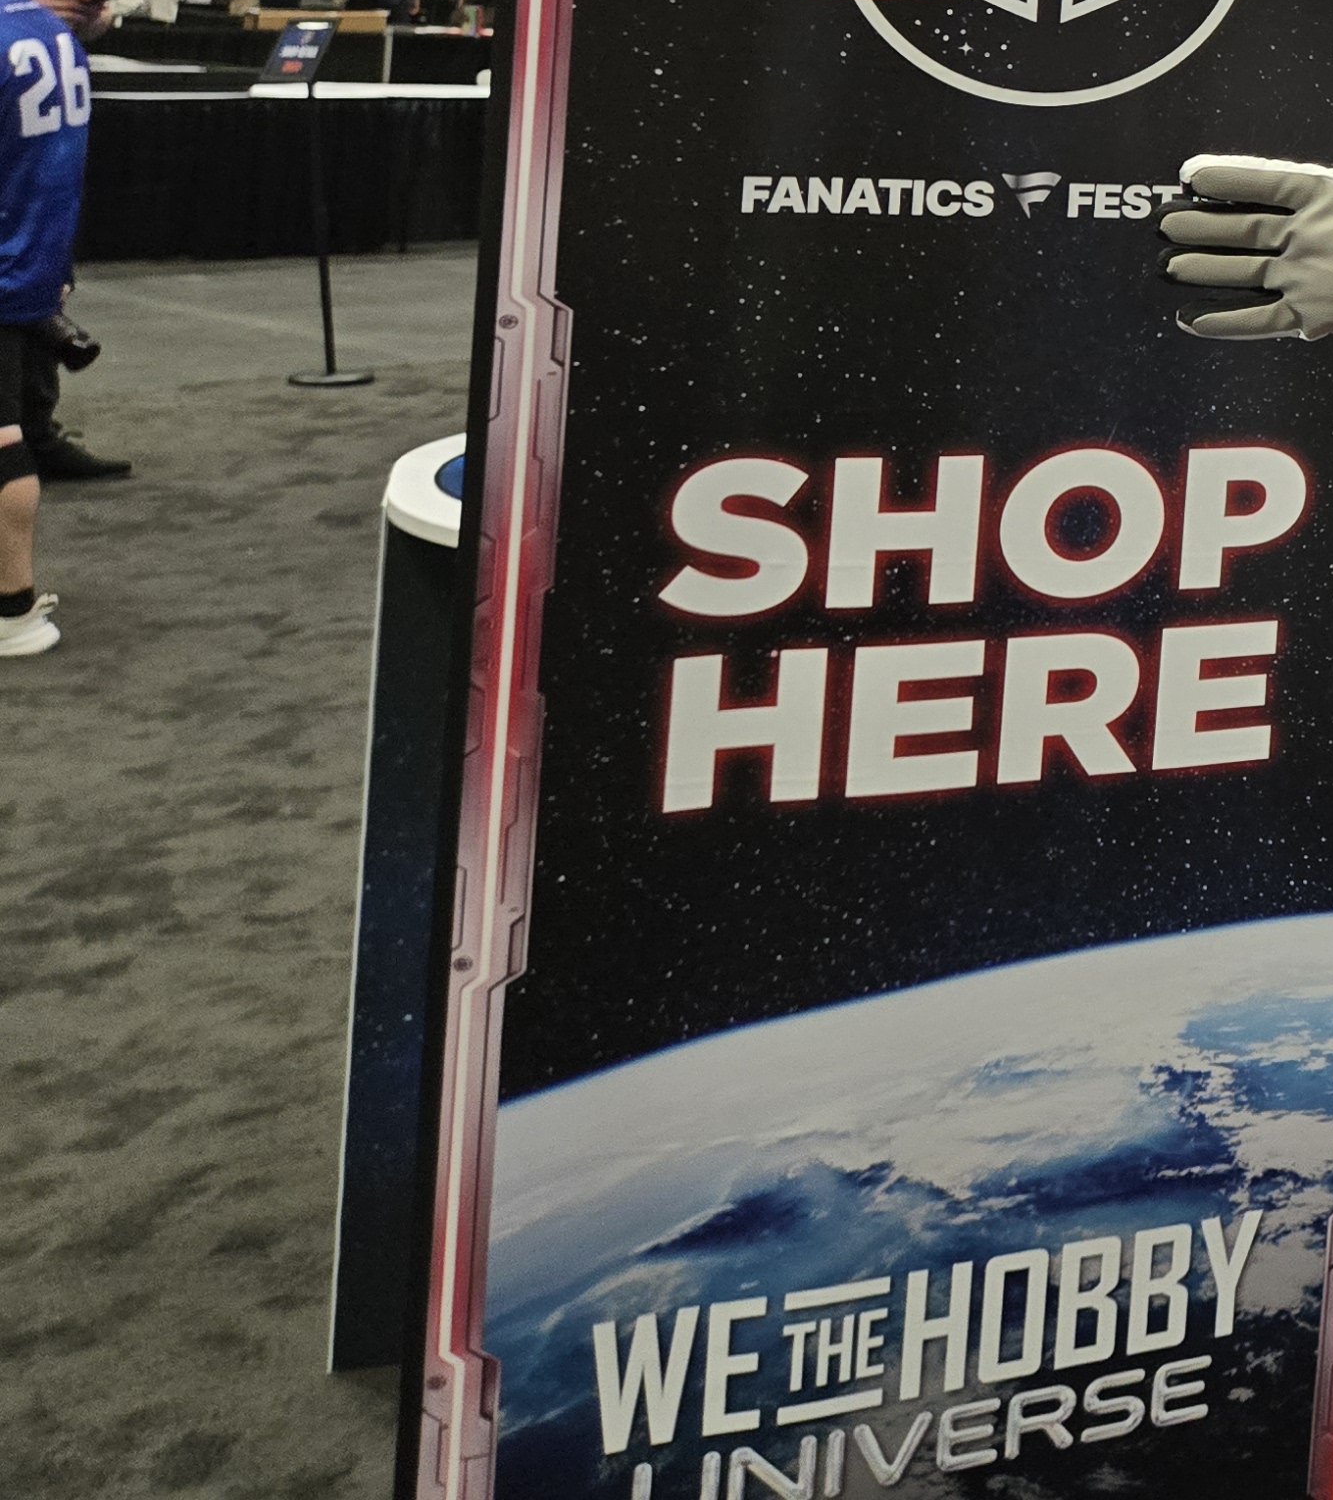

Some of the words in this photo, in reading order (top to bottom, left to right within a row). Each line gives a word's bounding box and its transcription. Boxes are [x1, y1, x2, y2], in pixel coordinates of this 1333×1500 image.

[8, 32, 92, 138] 26
[741, 176, 995, 217] FANATICS
[1067, 182, 1184, 220] FEST
[658, 446, 1308, 617] SHOP
[661, 619, 1279, 814] HERE
[592, 1296, 768, 1456] WE
[783, 1307, 888, 1393] THE
[899, 1208, 1264, 1401] HOBBY
[631, 1354, 1213, 1500] UNIVERSE
